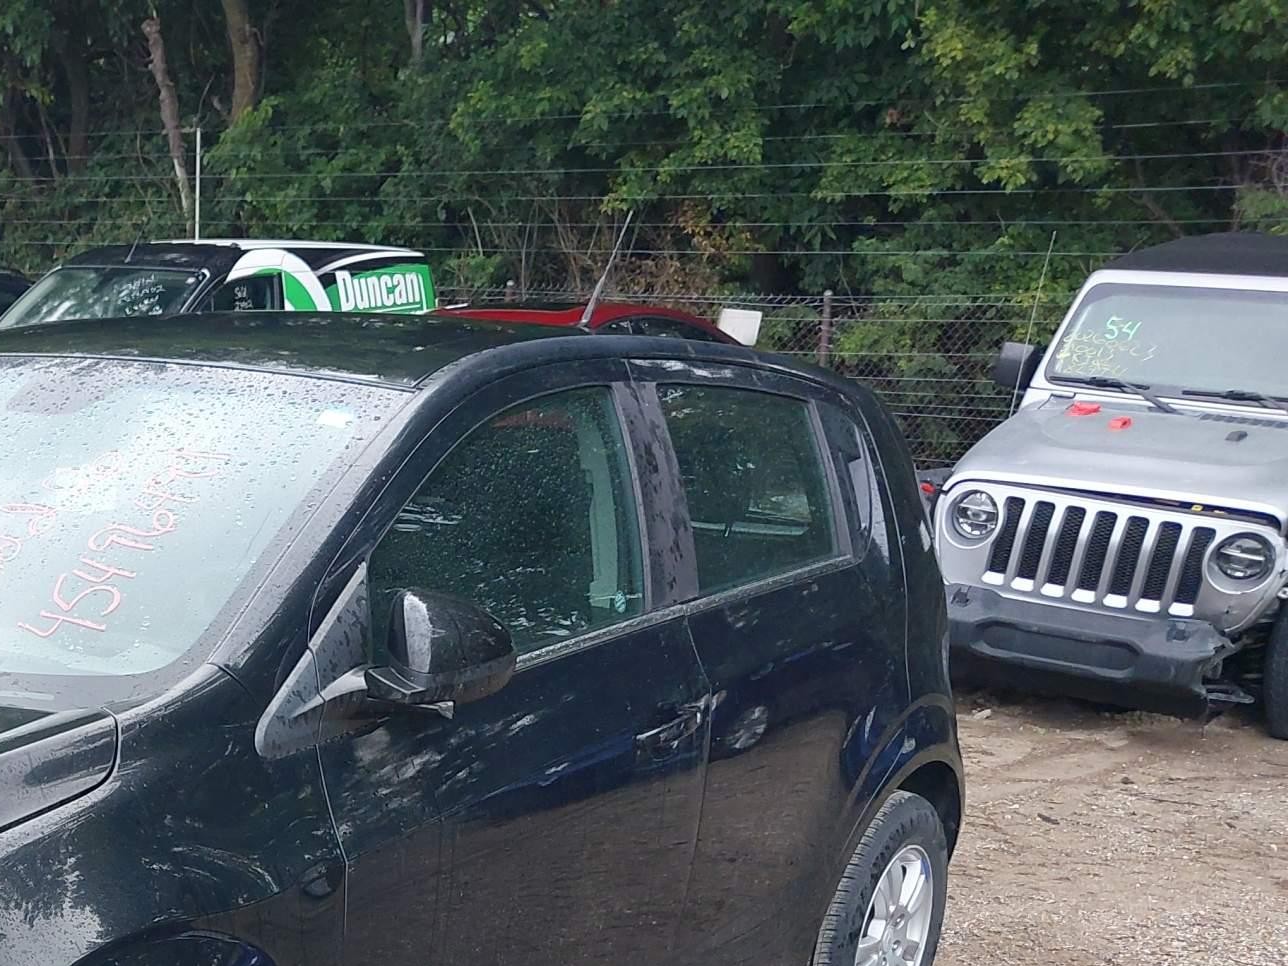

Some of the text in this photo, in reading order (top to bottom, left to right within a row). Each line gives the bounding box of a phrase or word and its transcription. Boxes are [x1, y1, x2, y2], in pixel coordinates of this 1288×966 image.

[335, 270, 420, 312] Duncan
[1104, 315, 1142, 340] 54
[16, 450, 231, 638] 45496491
